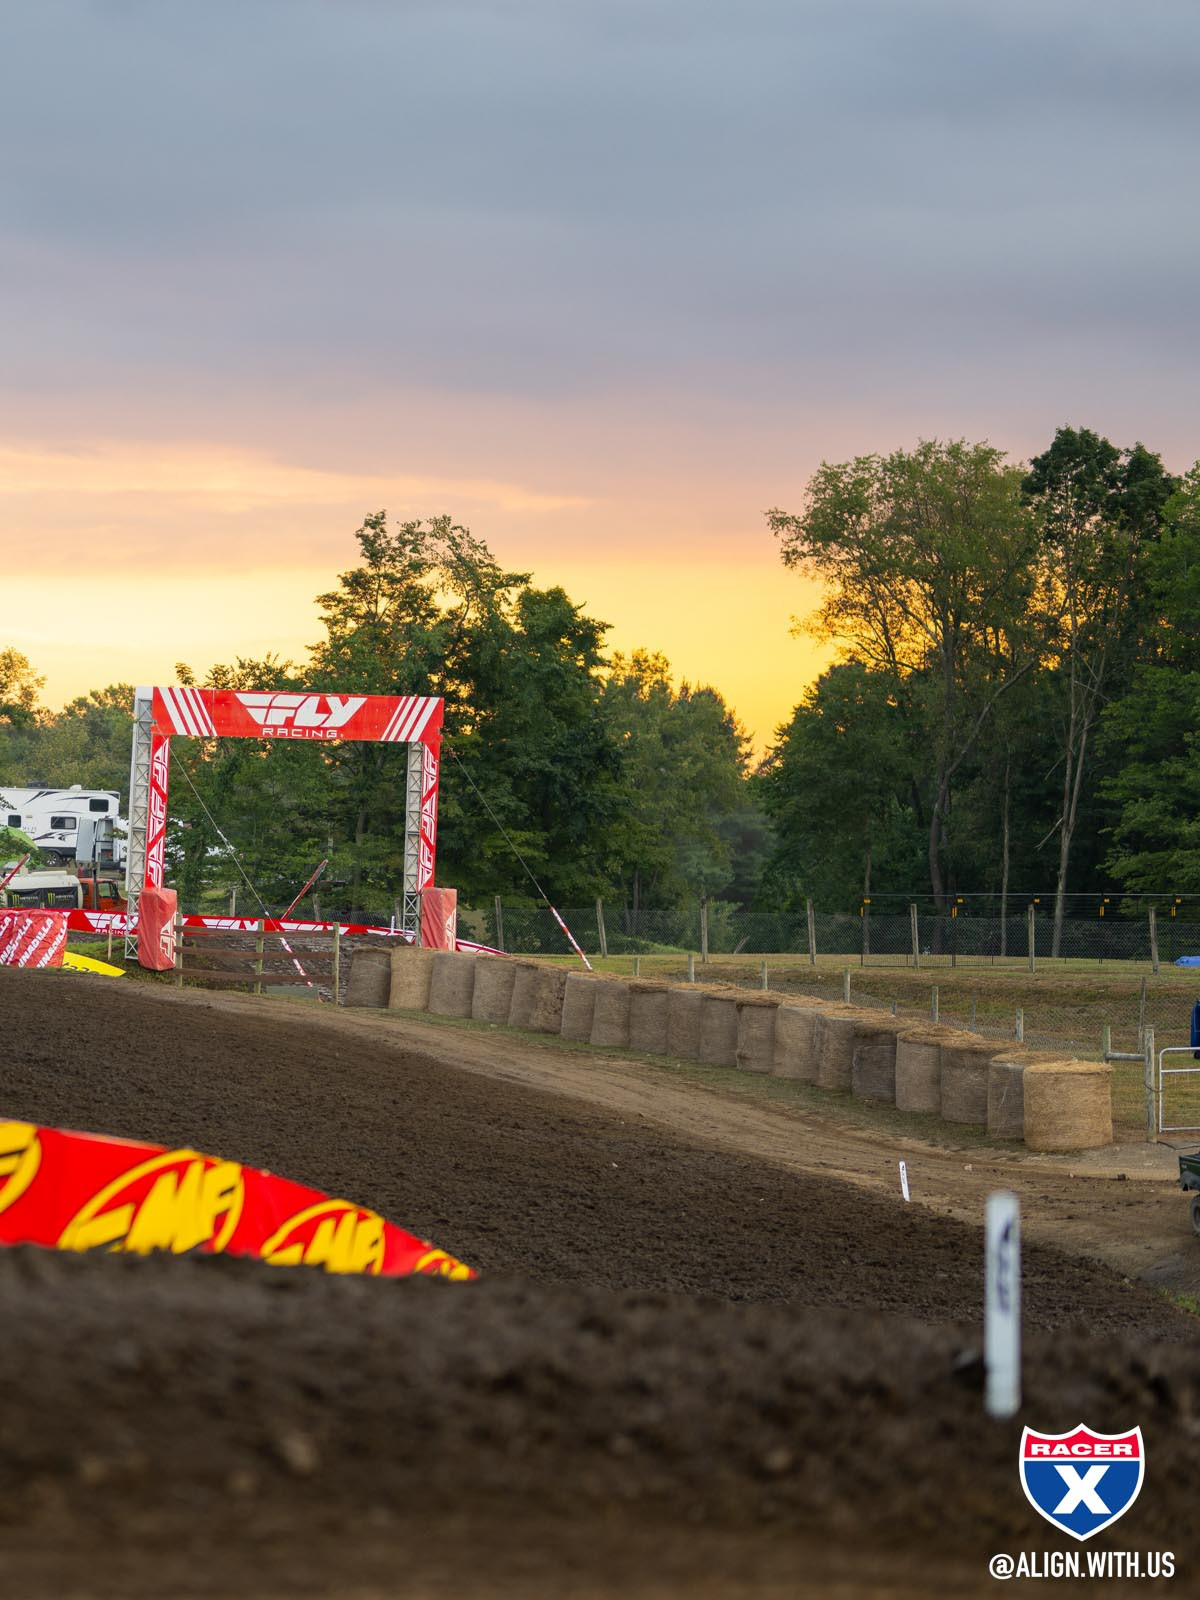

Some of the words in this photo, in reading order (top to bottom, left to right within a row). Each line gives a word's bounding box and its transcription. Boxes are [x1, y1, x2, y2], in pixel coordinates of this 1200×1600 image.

[235, 693, 368, 727] FLY
[262, 727, 338, 738] RACING
[18, 918, 54, 968] UNADILLA
